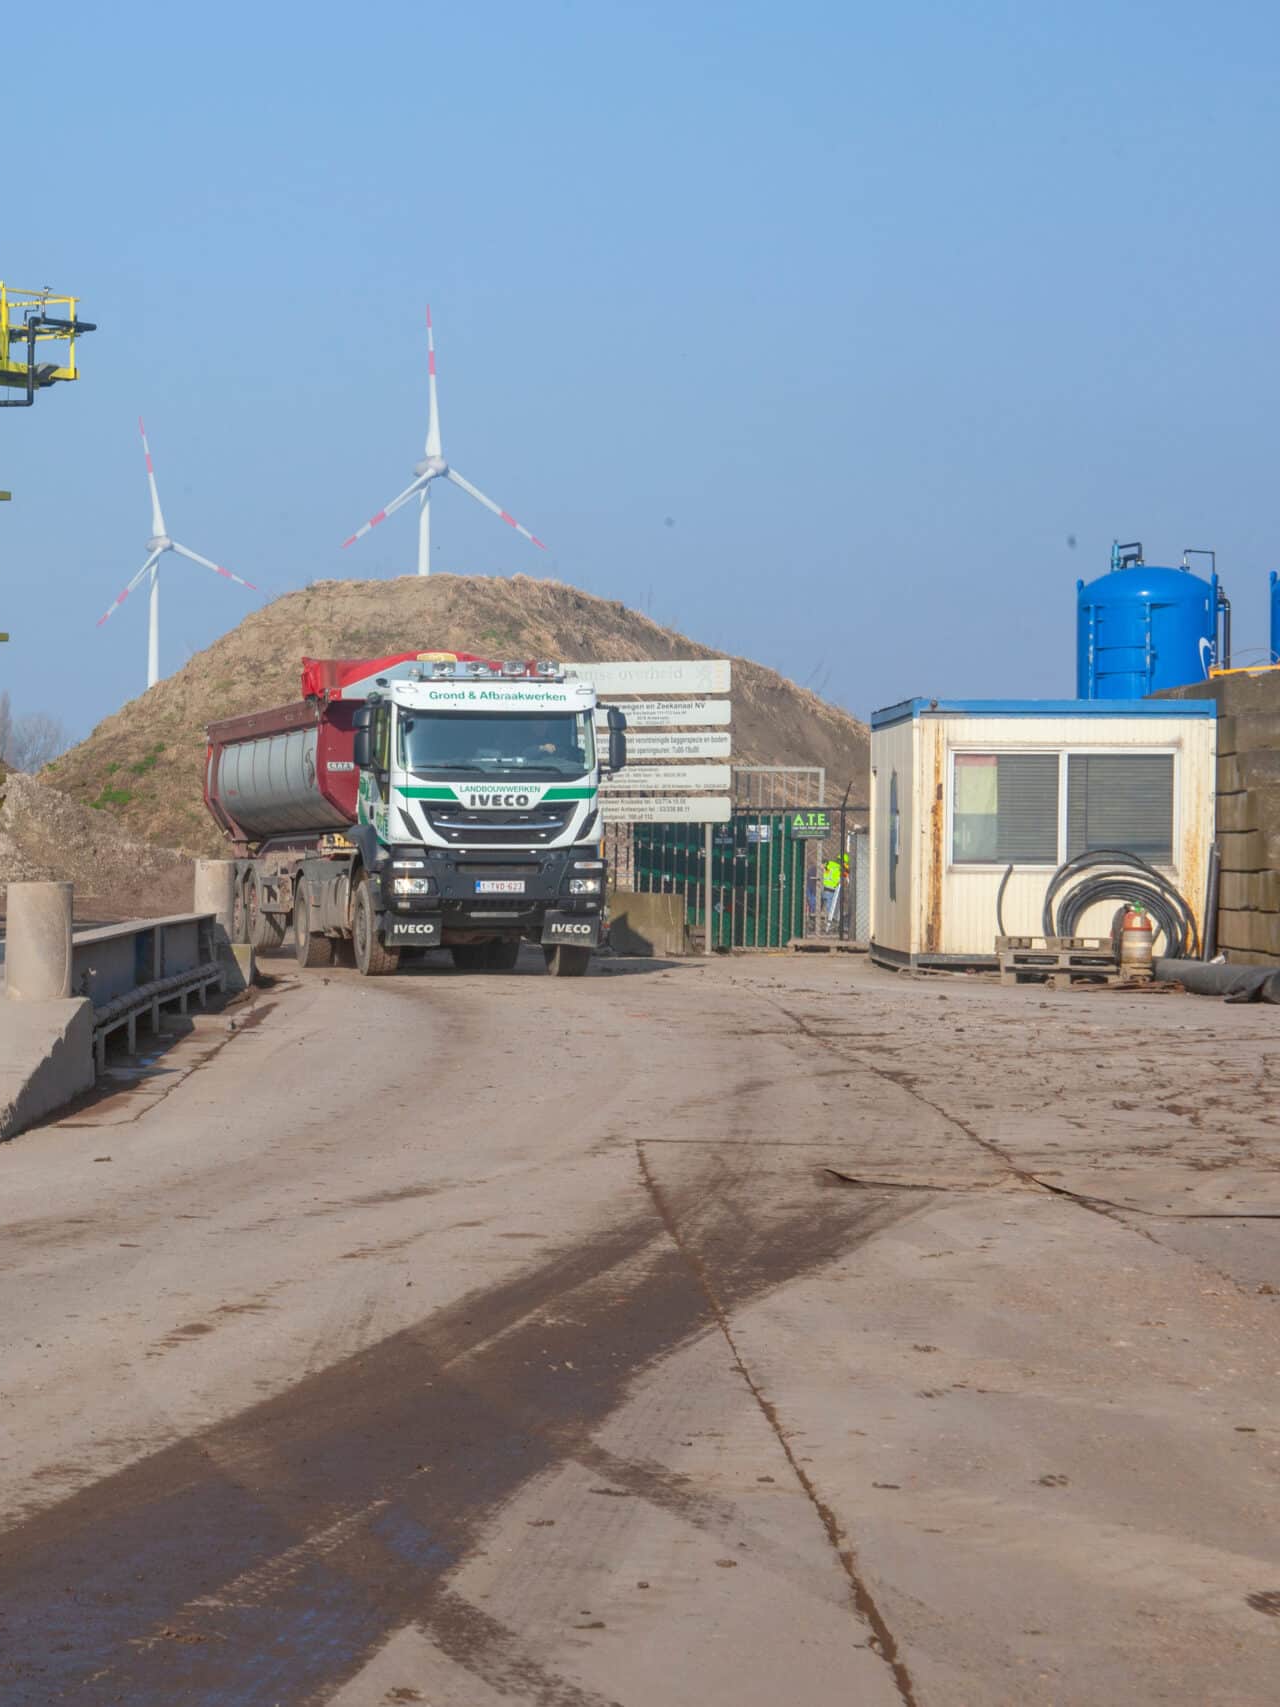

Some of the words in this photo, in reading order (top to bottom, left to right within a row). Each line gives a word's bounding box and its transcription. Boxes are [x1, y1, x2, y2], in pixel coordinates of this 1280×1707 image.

[429, 691, 465, 700] Grond
[468, 691, 477, 700] &
[480, 691, 567, 702] Afbraakwerken
[459, 785, 541, 793] LANDBOUWWERKEN
[470, 794, 529, 806] IVECO
[793, 813, 830, 826] A.T.E.
[393, 924, 434, 933] IVECO
[551, 923, 591, 933] IVECO
